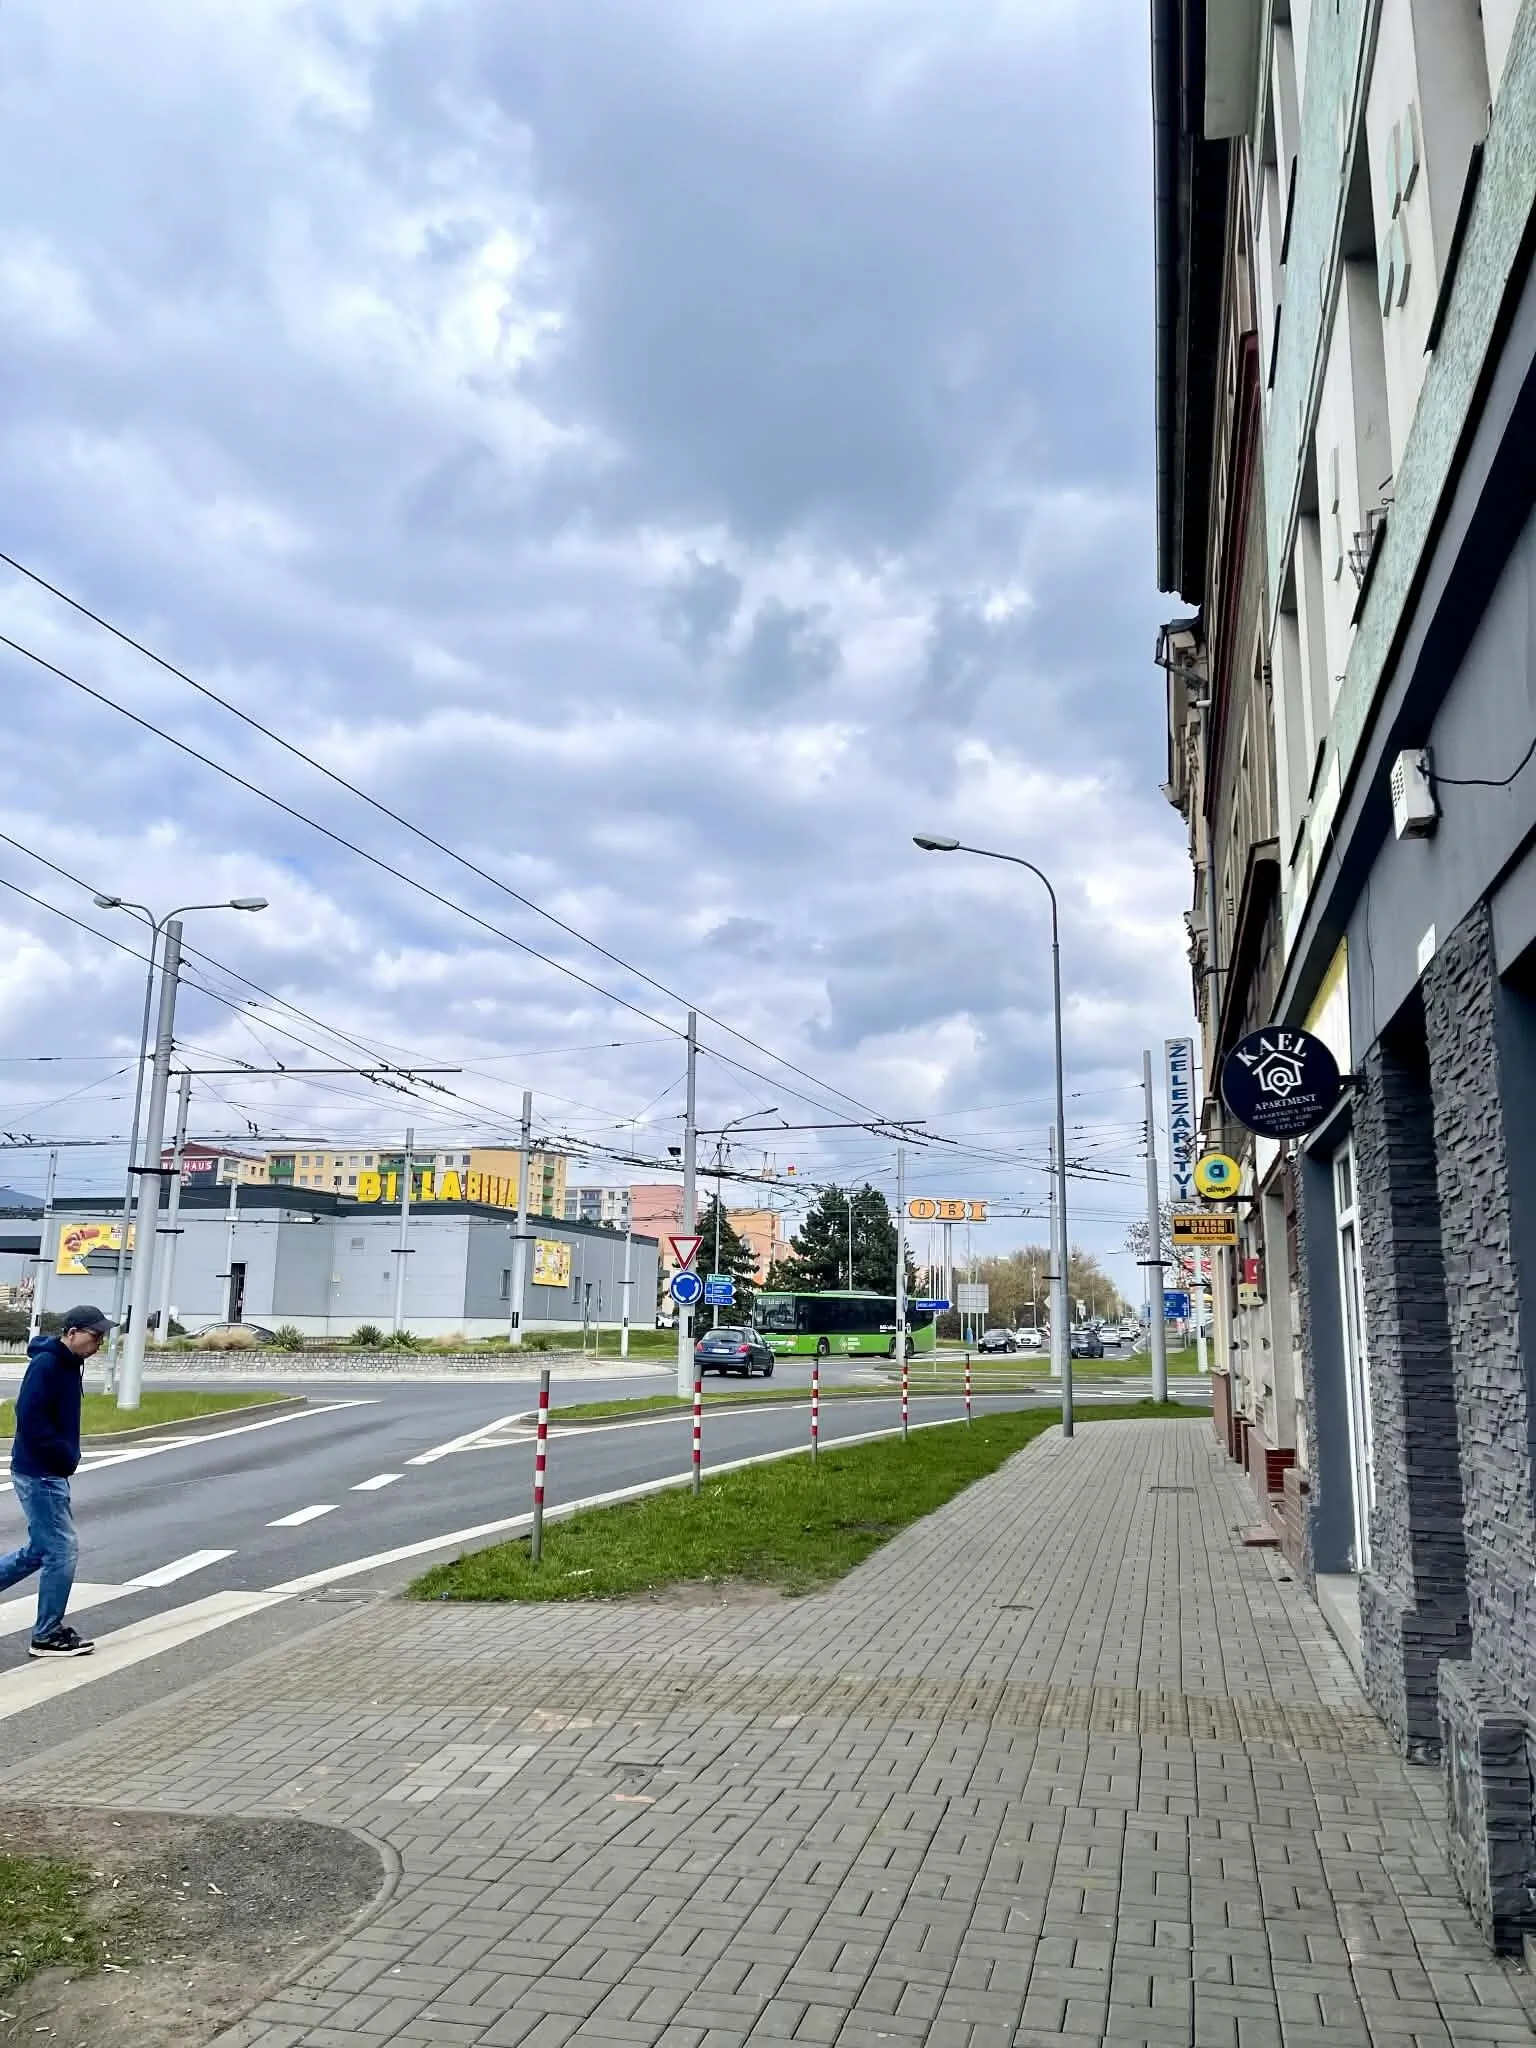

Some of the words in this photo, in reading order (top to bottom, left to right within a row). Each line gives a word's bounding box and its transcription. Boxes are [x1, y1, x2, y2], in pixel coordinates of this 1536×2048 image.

[1236, 1033, 1307, 1067] KAEL
[1254, 1094, 1317, 1110] APARTMENT
[162, 1160, 214, 1170] BAHAUS
[908, 1199, 987, 1221] OBI
[1191, 1226, 1225, 1234] UNION
